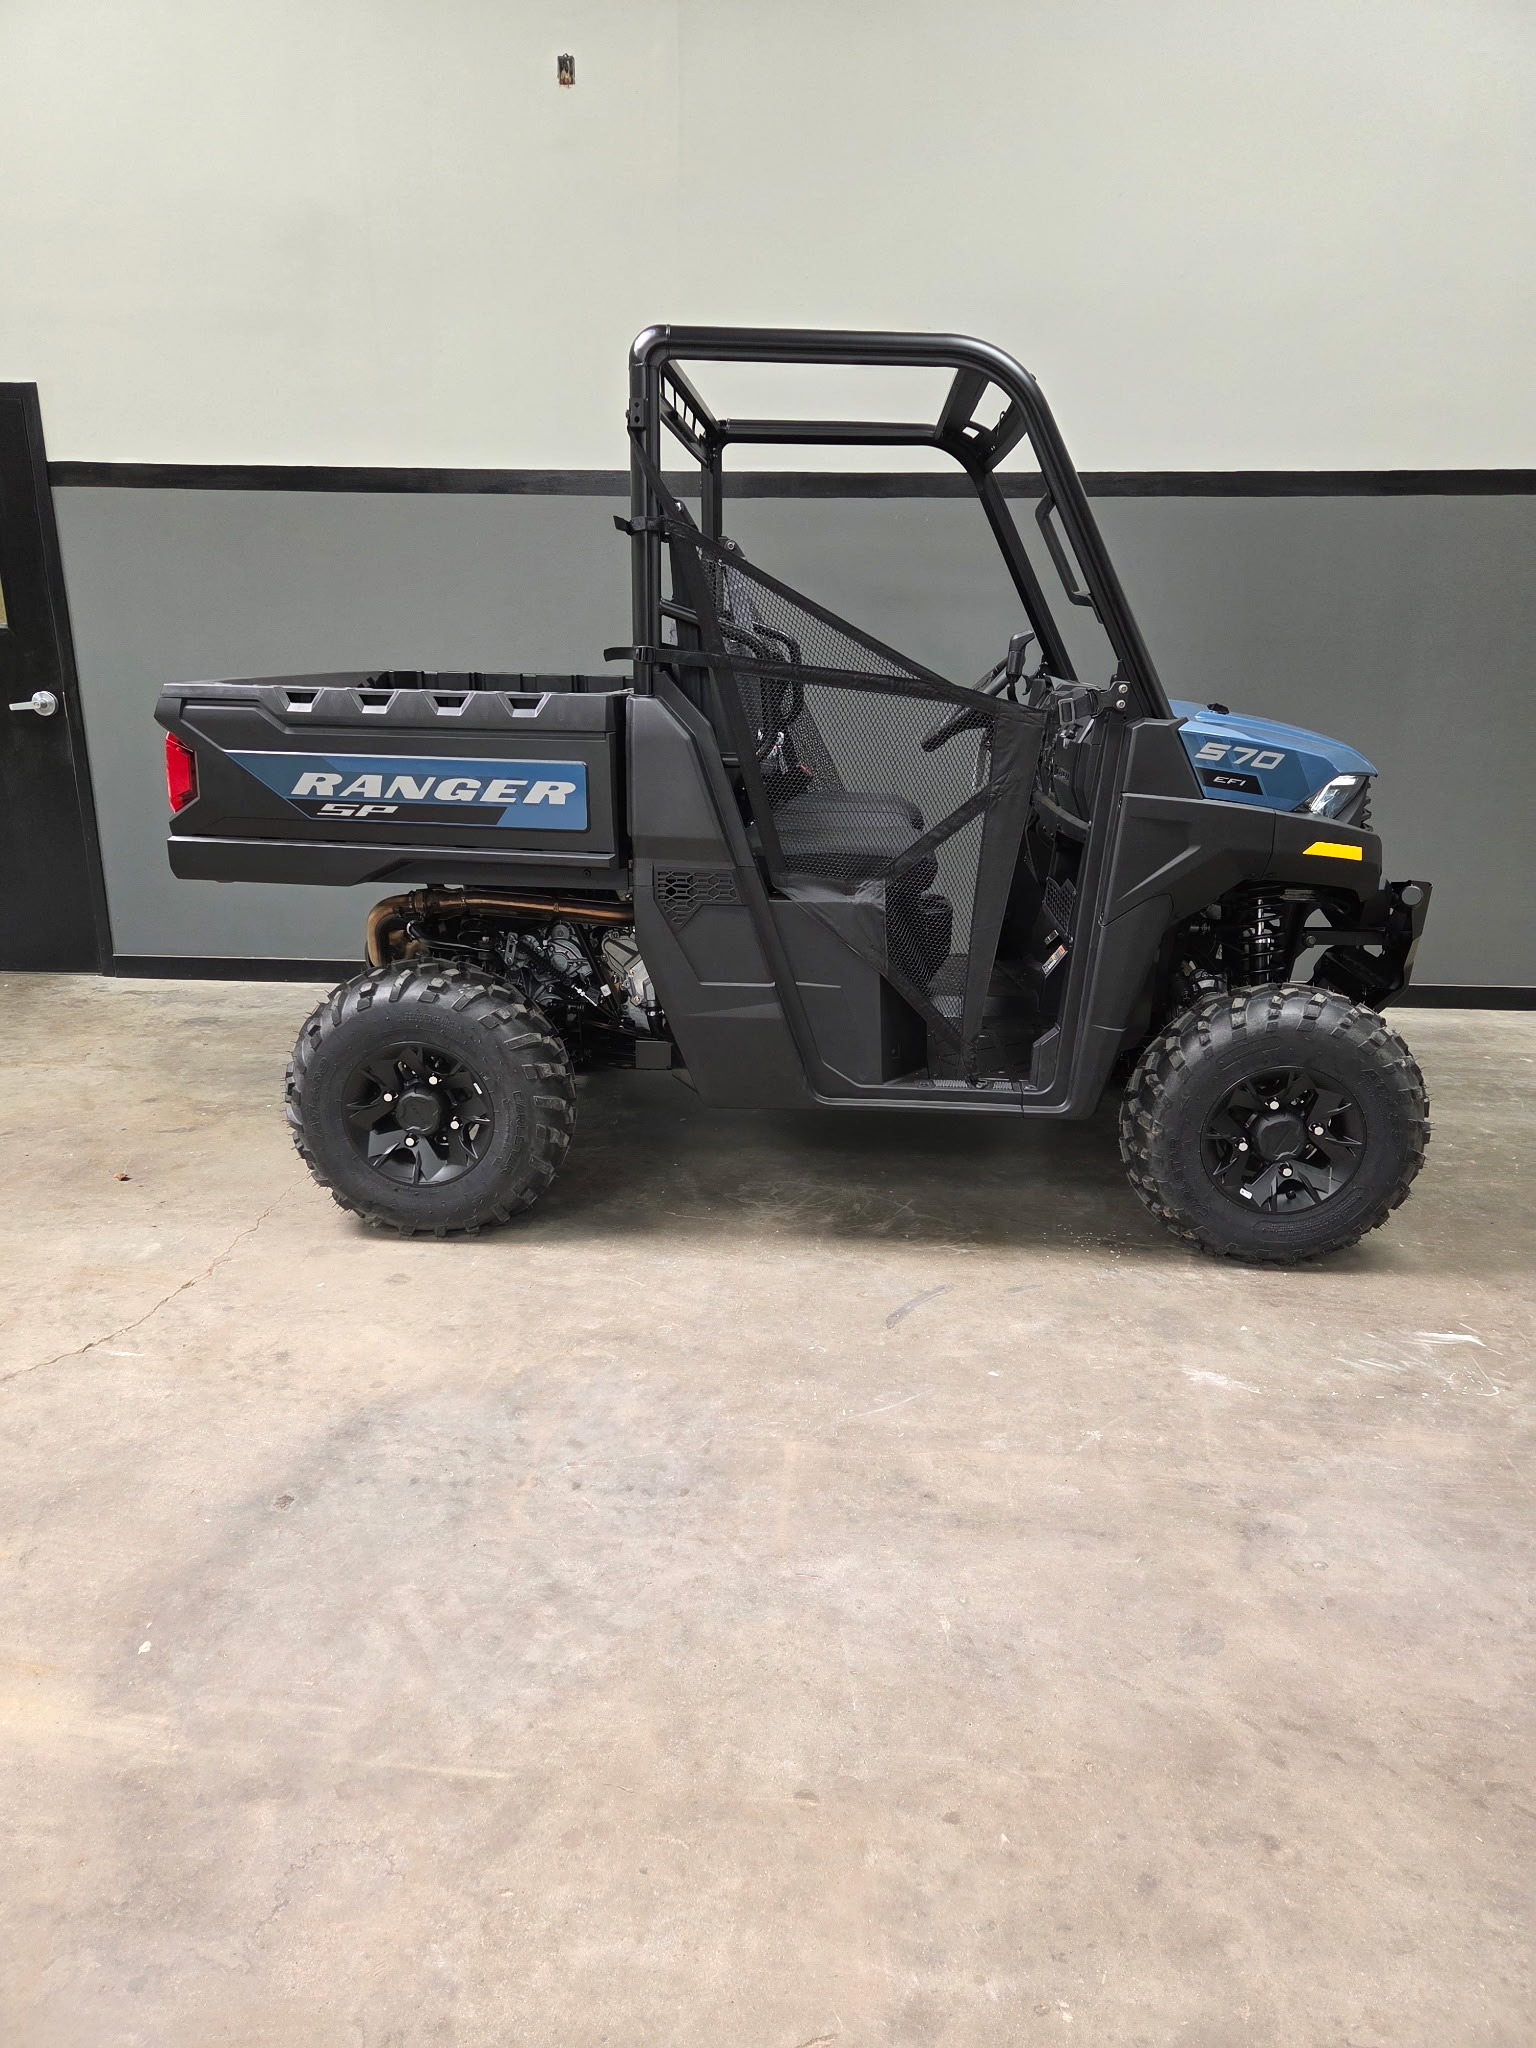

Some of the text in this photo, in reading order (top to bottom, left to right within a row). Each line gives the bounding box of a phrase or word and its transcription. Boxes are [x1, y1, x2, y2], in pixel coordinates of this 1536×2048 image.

[1195, 741, 1286, 770] 570
[292, 773, 577, 806] RANGER
[1213, 776, 1247, 787] EFI
[317, 804, 399, 817] SP
